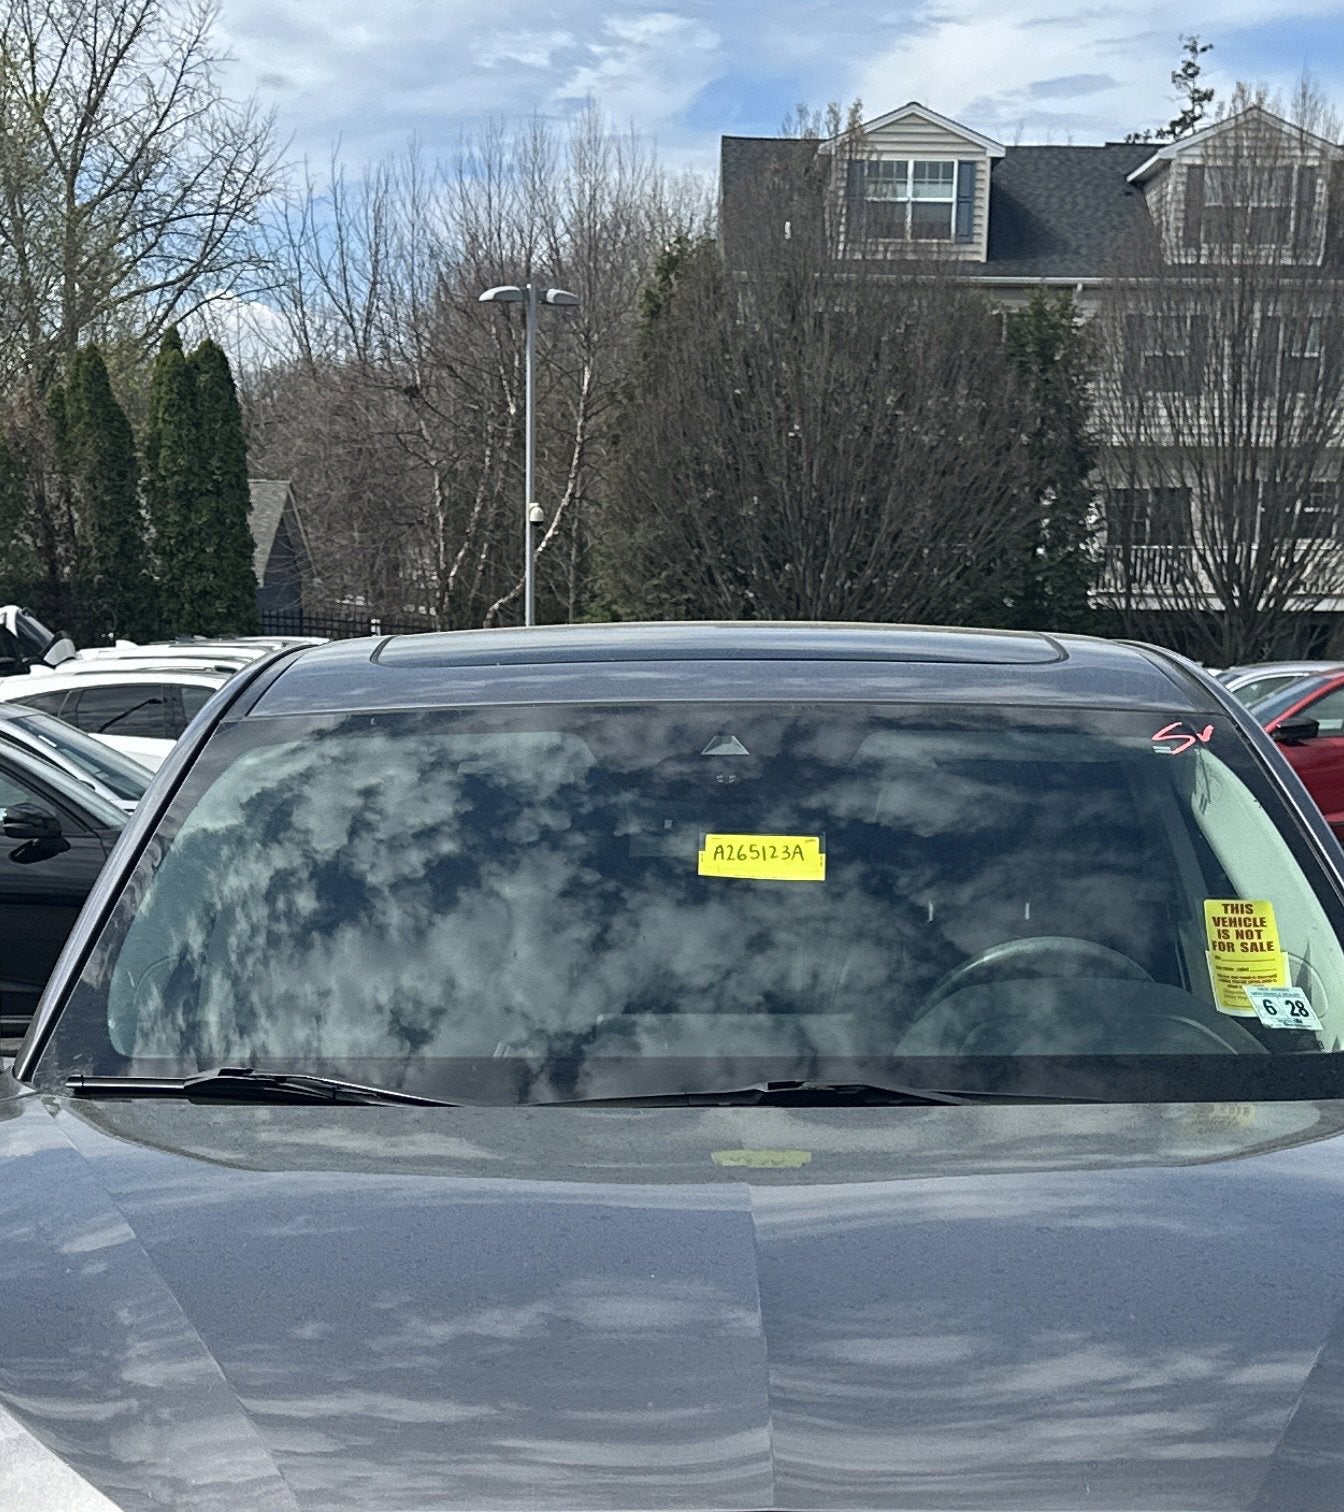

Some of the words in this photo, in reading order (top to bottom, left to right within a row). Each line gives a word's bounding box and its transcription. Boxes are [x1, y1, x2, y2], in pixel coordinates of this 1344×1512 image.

[713, 844, 805, 861] A265123A
[1221, 903, 1254, 915] THIS
[1211, 916, 1267, 928] VEHICLE
[1217, 928, 1230, 940] IS
[1235, 928, 1263, 940] NOT
[1211, 940, 1236, 952] FOR
[1240, 941, 1275, 953] SALE
[1263, 999, 1277, 1016] 6
[1285, 1000, 1309, 1017] 28
